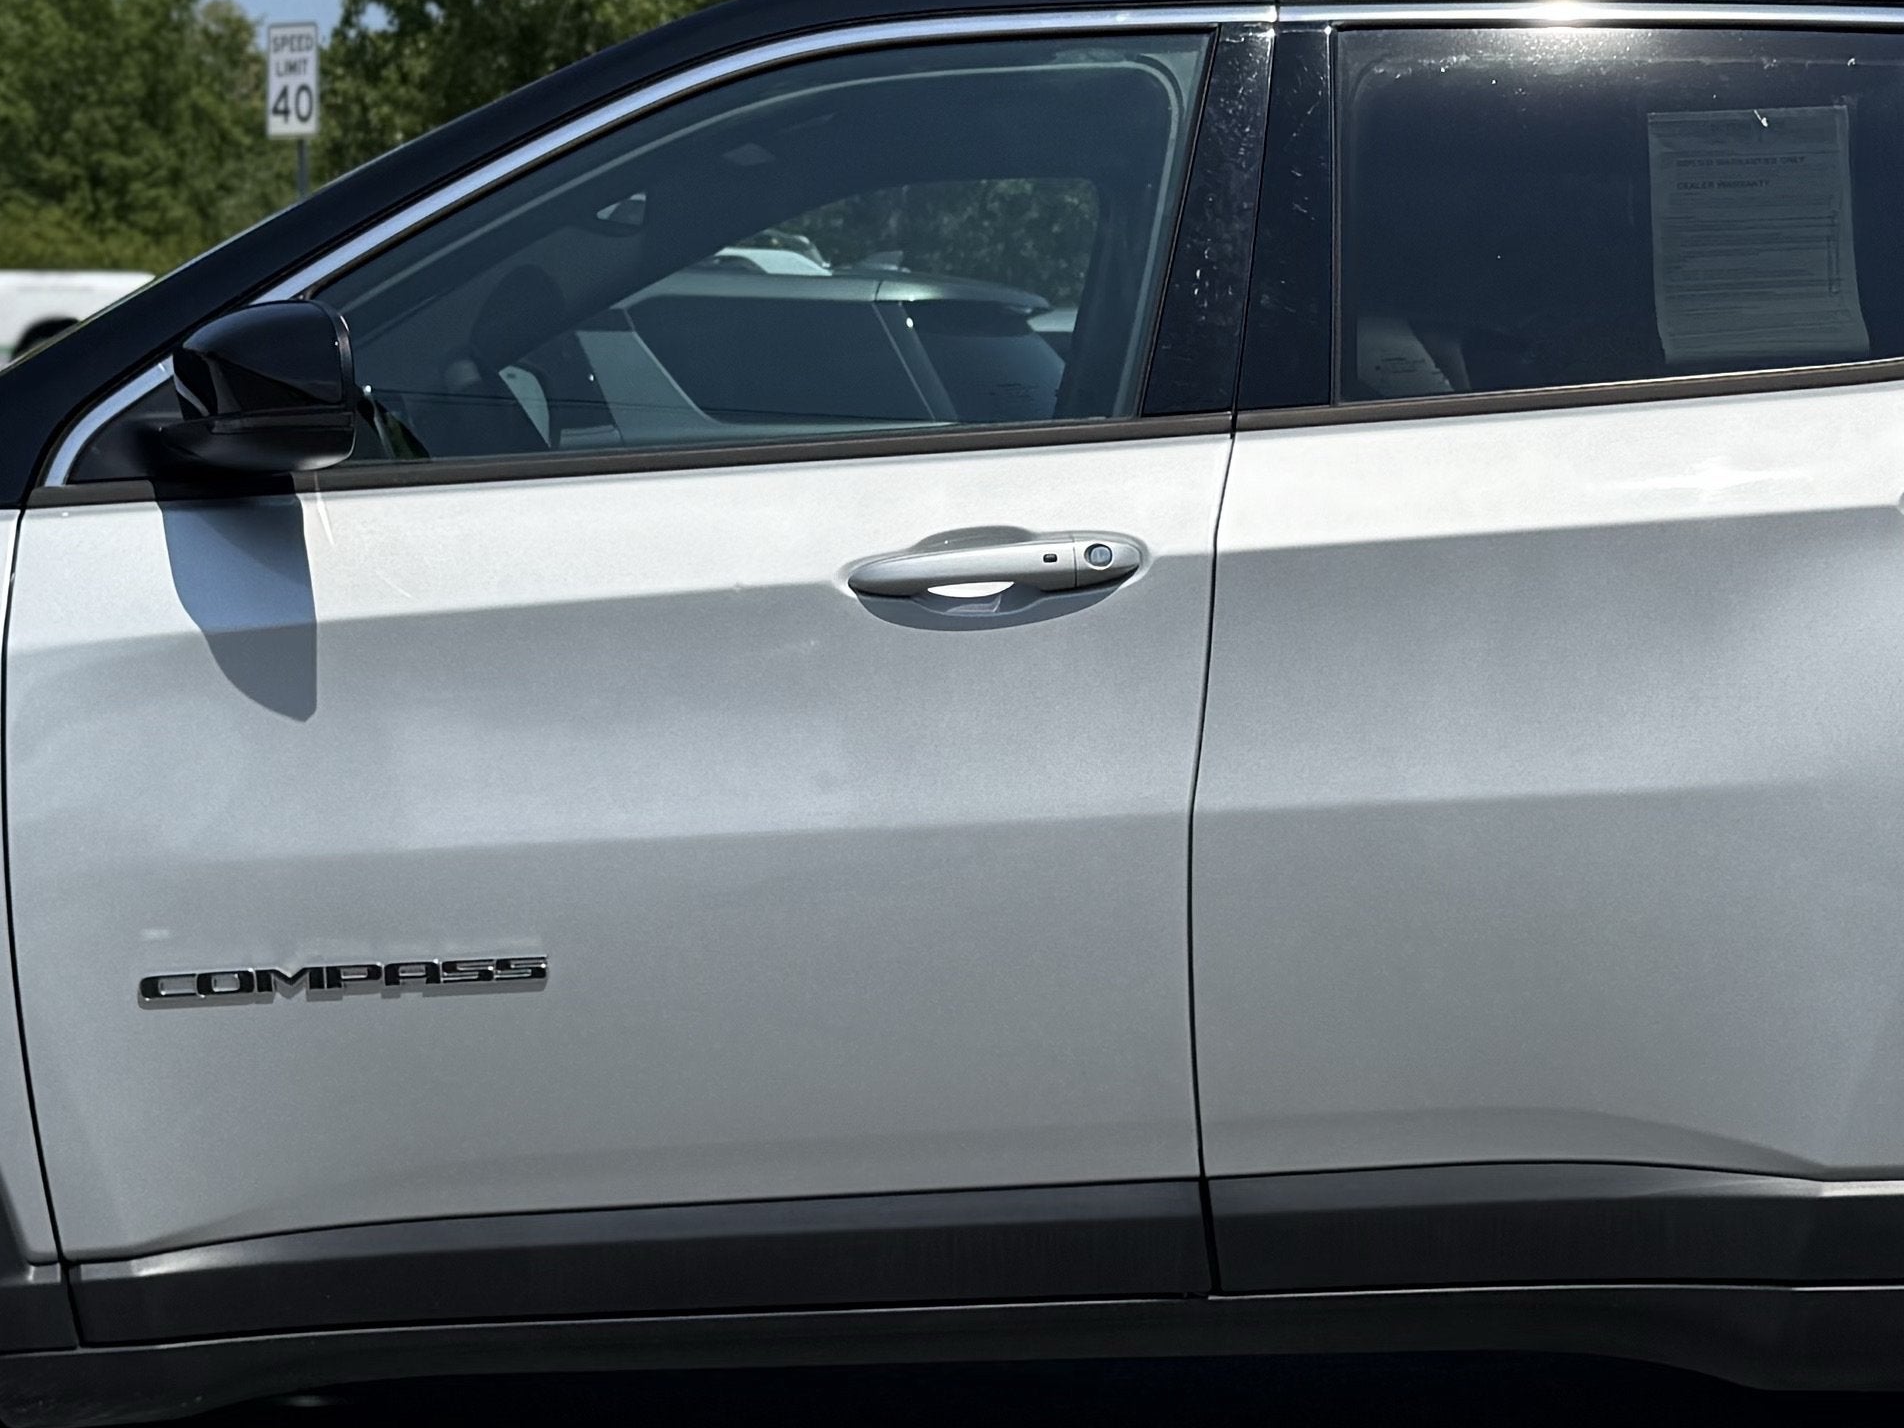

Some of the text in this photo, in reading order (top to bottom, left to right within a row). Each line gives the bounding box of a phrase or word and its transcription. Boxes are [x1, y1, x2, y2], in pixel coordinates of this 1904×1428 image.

[271, 34, 314, 53] SPEED
[275, 58, 309, 77] LIMIT
[271, 84, 314, 124] 40
[138, 955, 549, 1006] COMPASS
